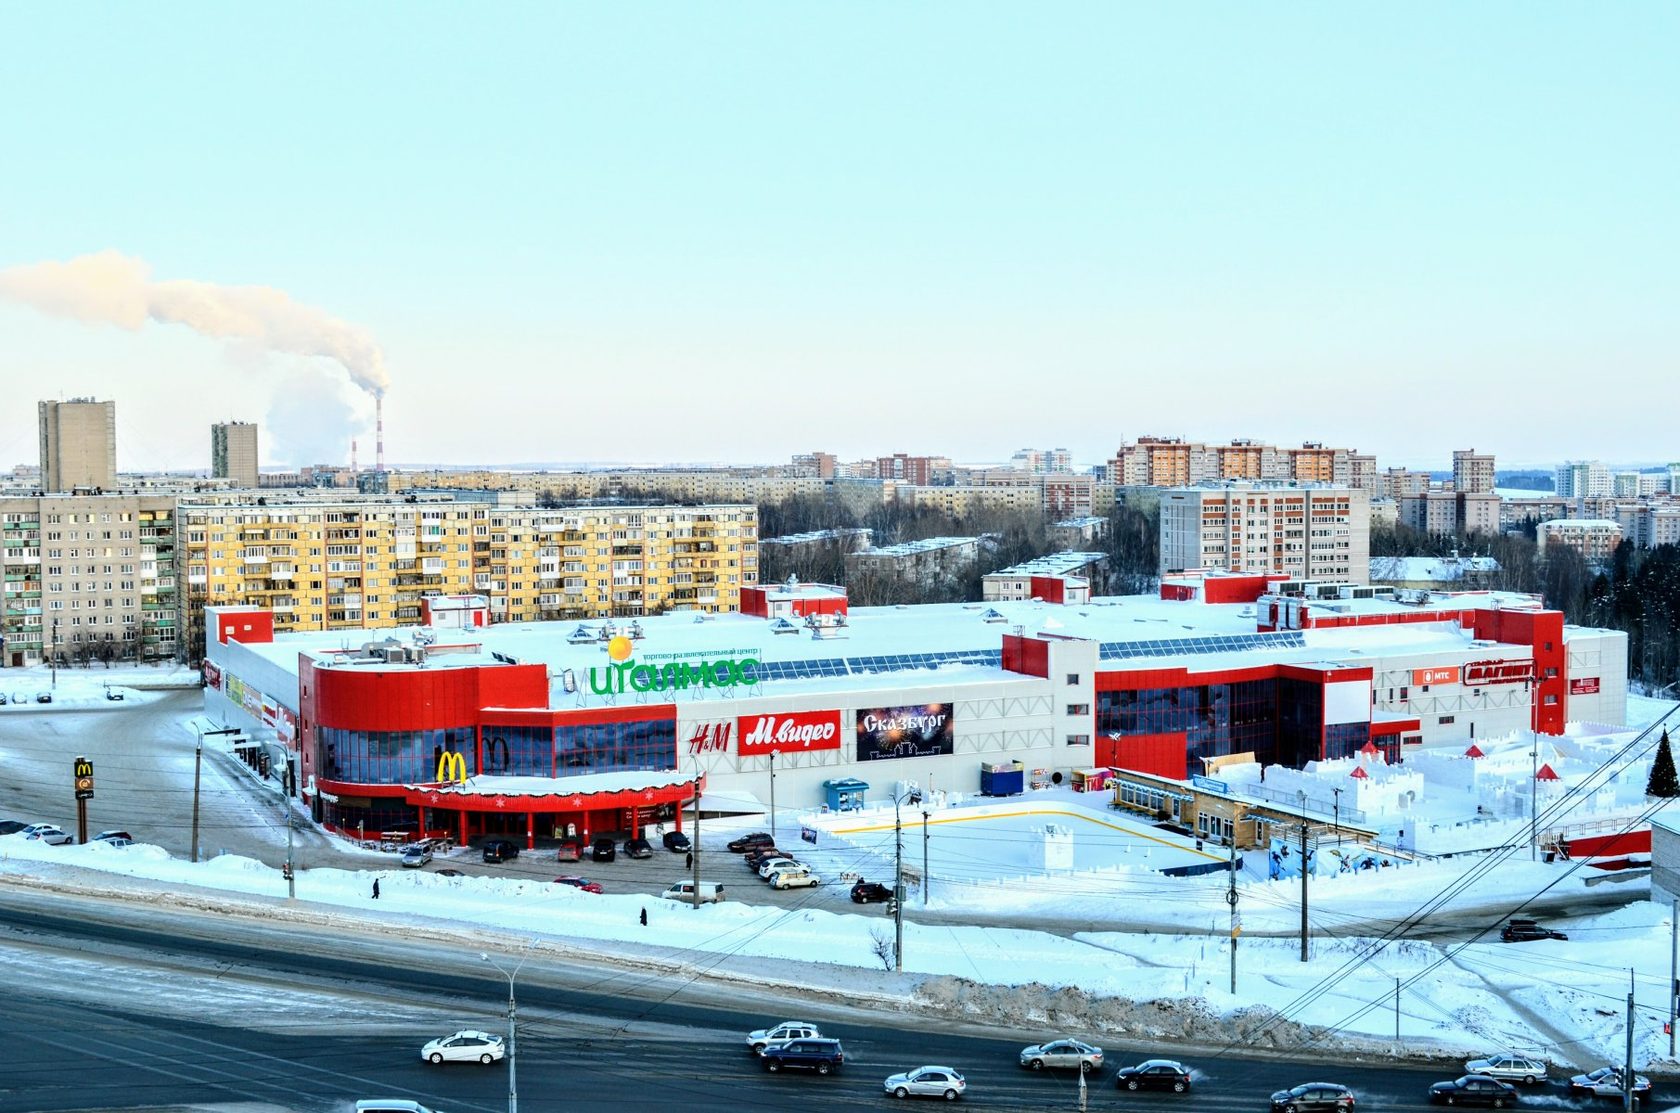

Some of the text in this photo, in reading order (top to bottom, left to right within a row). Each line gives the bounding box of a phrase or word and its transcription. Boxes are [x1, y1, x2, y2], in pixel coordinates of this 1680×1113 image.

[737, 648, 758, 656] центр
[1434, 672, 1450, 680] МТС
[746, 716, 835, 747] М.видео
[864, 714, 946, 737] Сказбург
[689, 722, 731, 754] H&M
